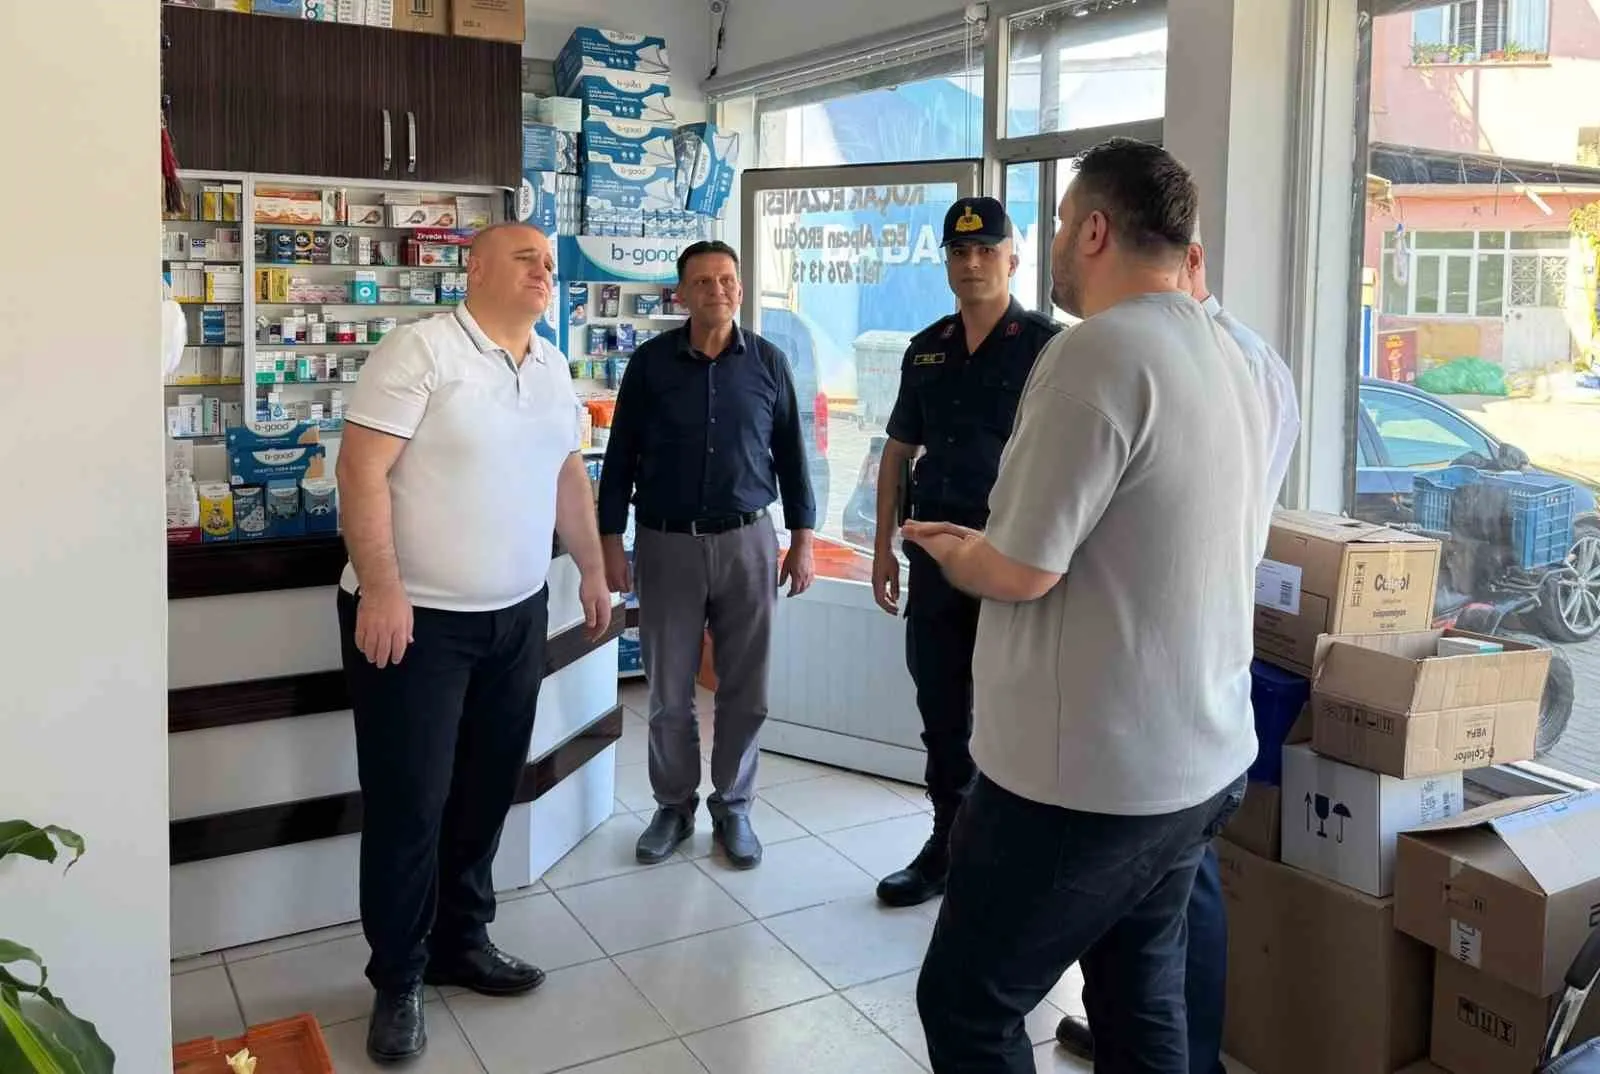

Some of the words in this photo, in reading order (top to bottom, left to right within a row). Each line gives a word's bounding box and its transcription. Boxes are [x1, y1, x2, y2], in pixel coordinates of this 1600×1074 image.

[611, 243, 679, 265] b-good
[254, 422, 289, 433] b-good
[264, 451, 294, 461] b-good
[1374, 573, 1410, 594] Capol
